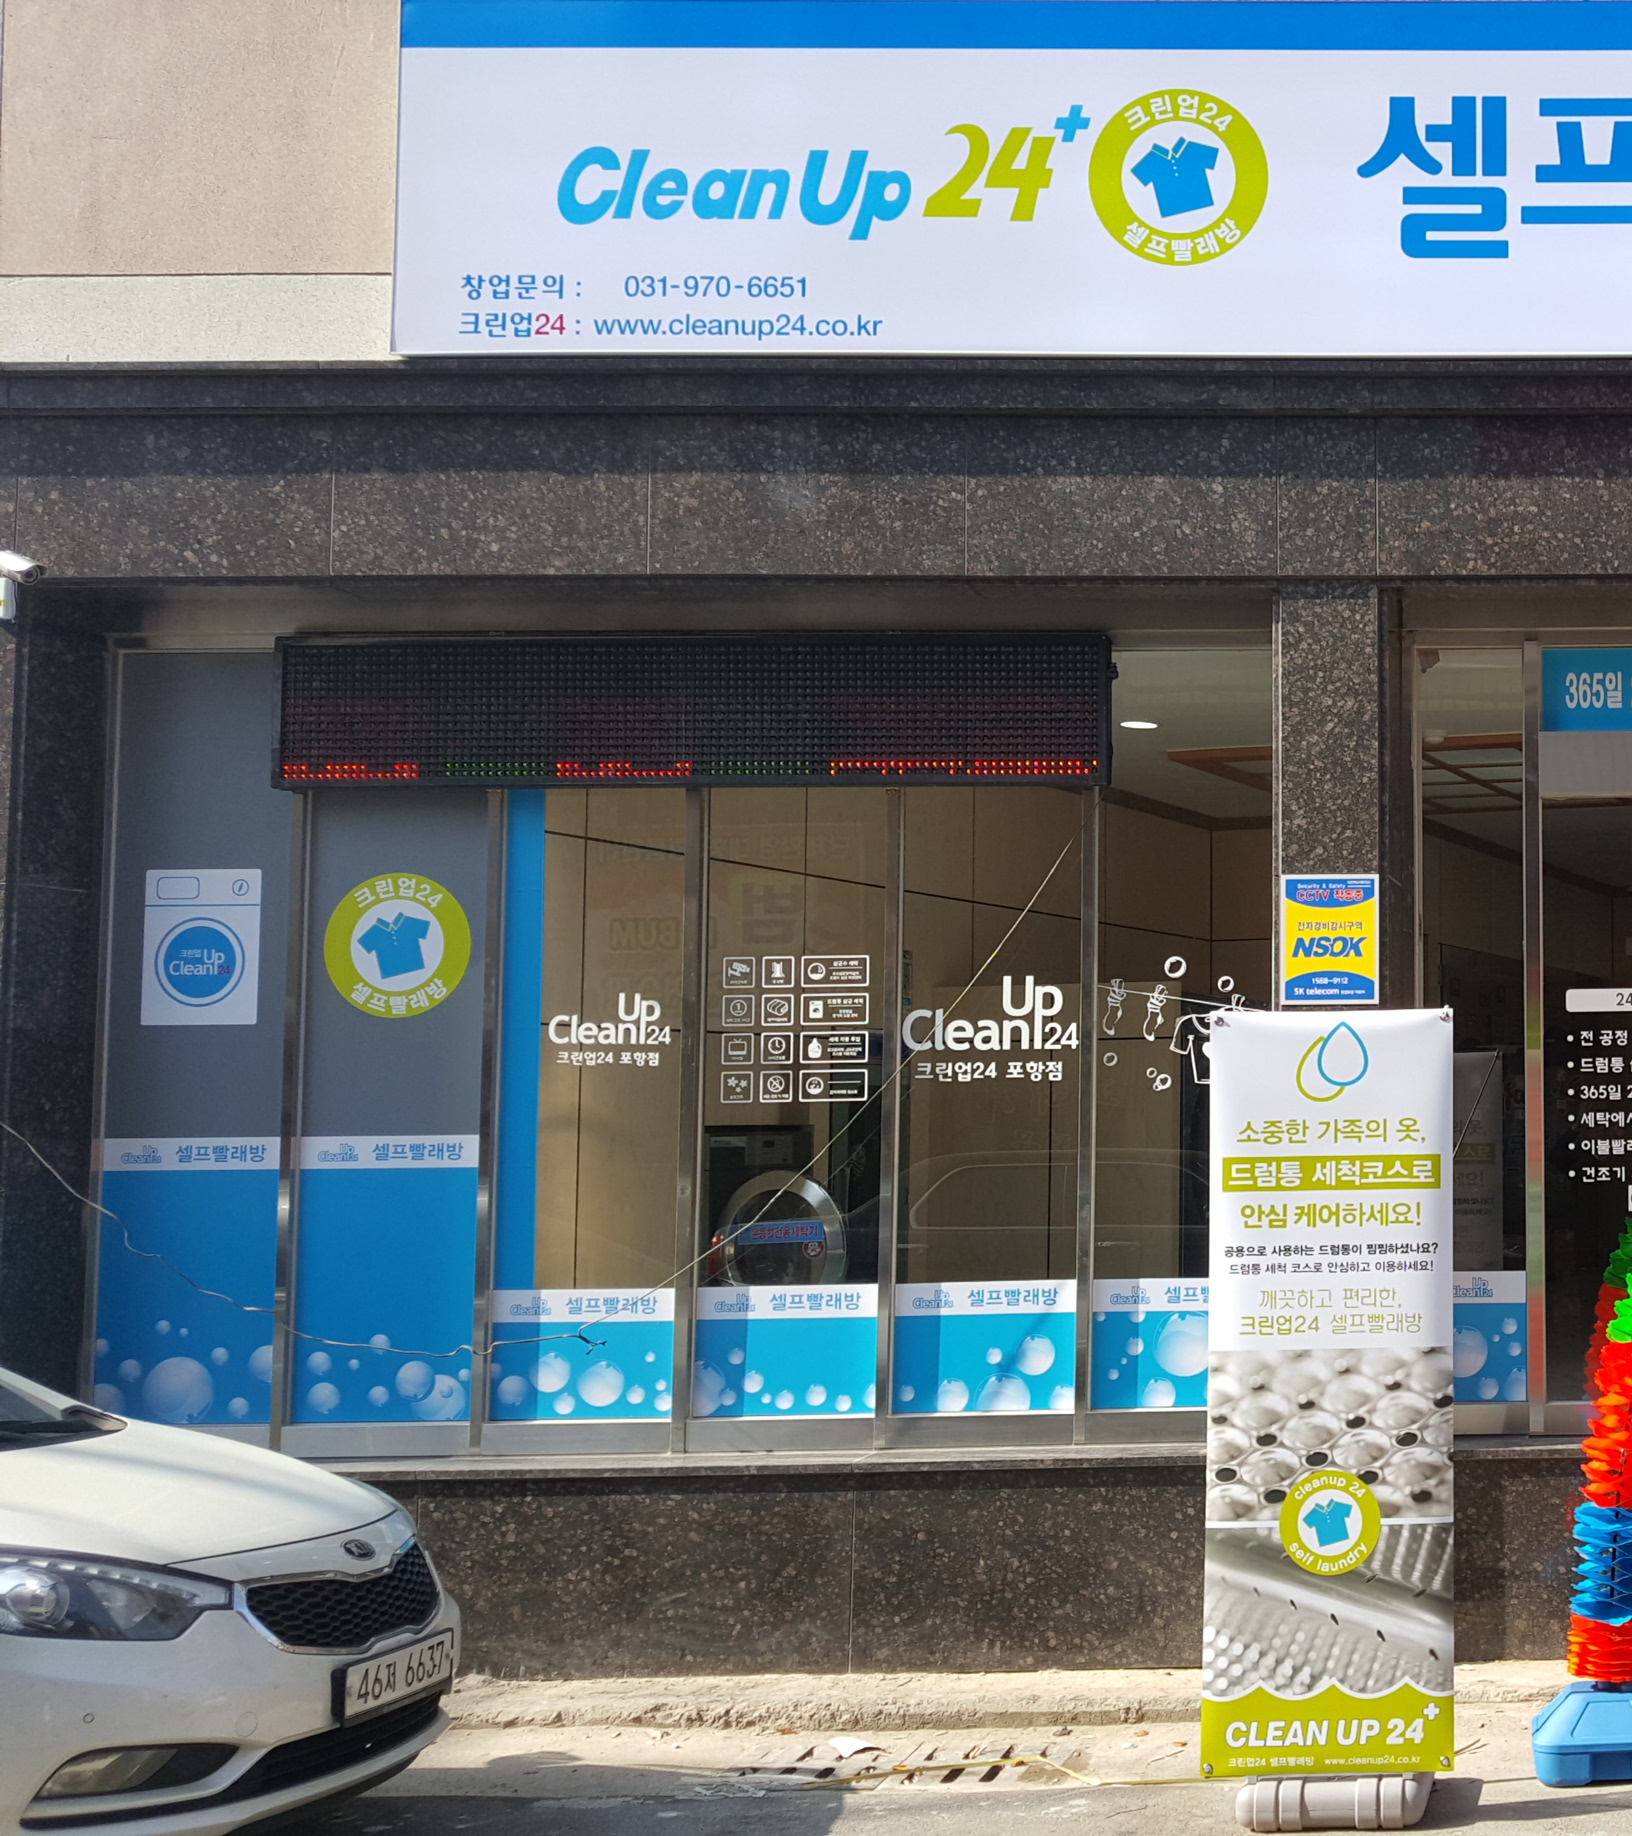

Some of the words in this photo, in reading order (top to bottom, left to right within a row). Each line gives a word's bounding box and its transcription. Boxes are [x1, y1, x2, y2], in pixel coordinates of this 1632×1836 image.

[1124, 92, 1236, 134] 크린업24
[557, 146, 790, 226] Clean
[800, 149, 912, 240] Up
[1123, 217, 1243, 262] 셀프빨래방
[460, 273, 565, 300] 창업문의
[624, 277, 808, 298] 031-970-6651
[458, 311, 566, 338] 크린업24
[594, 314, 883, 341] www.cleanup24.co.kr
[1566, 672, 1623, 709] 365일
[354, 877, 443, 908] 크린업24
[1296, 889, 1330, 901] CCTV
[1291, 936, 1368, 958] NSOK
[350, 978, 449, 1014] 셀프빨래방
[1294, 987, 1304, 996] SK
[1306, 987, 1340, 995] telecom
[647, 1026, 671, 1045] 24
[1044, 1022, 1079, 1050] 24
[1580, 1031, 1593, 1046] 전
[1599, 1030, 1628, 1046] 공정
[556, 1051, 613, 1067] 크린업24
[619, 1051, 660, 1067] 포항점
[1580, 1057, 1624, 1073] 드럼통
[915, 1062, 997, 1081] 크린업24
[1006, 1061, 1063, 1082] 포항점
[1580, 1085, 1621, 1100] 365일
[1237, 1119, 1309, 1145] 소중한
[1318, 1118, 1388, 1144] 가족의
[1396, 1117, 1426, 1144] 옷,
[176, 1144, 267, 1163] 셀프빨래방
[372, 1142, 464, 1161] 셀프빨래방
[1228, 1161, 1303, 1188] 드럼통
[1312, 1160, 1435, 1186] 세척코스로
[1582, 1166, 1625, 1182] 건조기
[1240, 1203, 1288, 1229] 안심
[1294, 1202, 1422, 1228] 케어하세요!
[1224, 1246, 1267, 1258] 공용으로
[1271, 1245, 1314, 1257] 사용하는
[1318, 1244, 1362, 1256] 드럼통이
[1229, 1264, 1261, 1275] 드럼통
[1265, 1263, 1287, 1274] 세척
[1290, 1262, 1323, 1273] 코스로
[1327, 1261, 1371, 1273] 안심하고
[1375, 1260, 1434, 1272] 이용하세요!
[565, 1296, 658, 1315] 셀프빨래방
[769, 1292, 861, 1312] 셀프빨래방
[968, 1287, 1059, 1307] 셀프빨래방
[1259, 1289, 1333, 1310] 깨끗하고
[1343, 1287, 1402, 1309] 편리한,
[1239, 1315, 1320, 1336] 크린업24
[1330, 1313, 1423, 1335] 셀프빨래방
[1294, 1476, 1347, 1501] cleanup
[1348, 1482, 1367, 1498] 24
[1289, 1541, 1314, 1567] self
[1317, 1542, 1369, 1572] laundry
[357, 1661, 397, 1704] 46저
[405, 1640, 445, 1687] 6637
[1226, 1719, 1329, 1748] CLEAN
[1336, 1719, 1380, 1746] UP
[1324, 1755, 1421, 1767] www.cleanup24.co.kr
